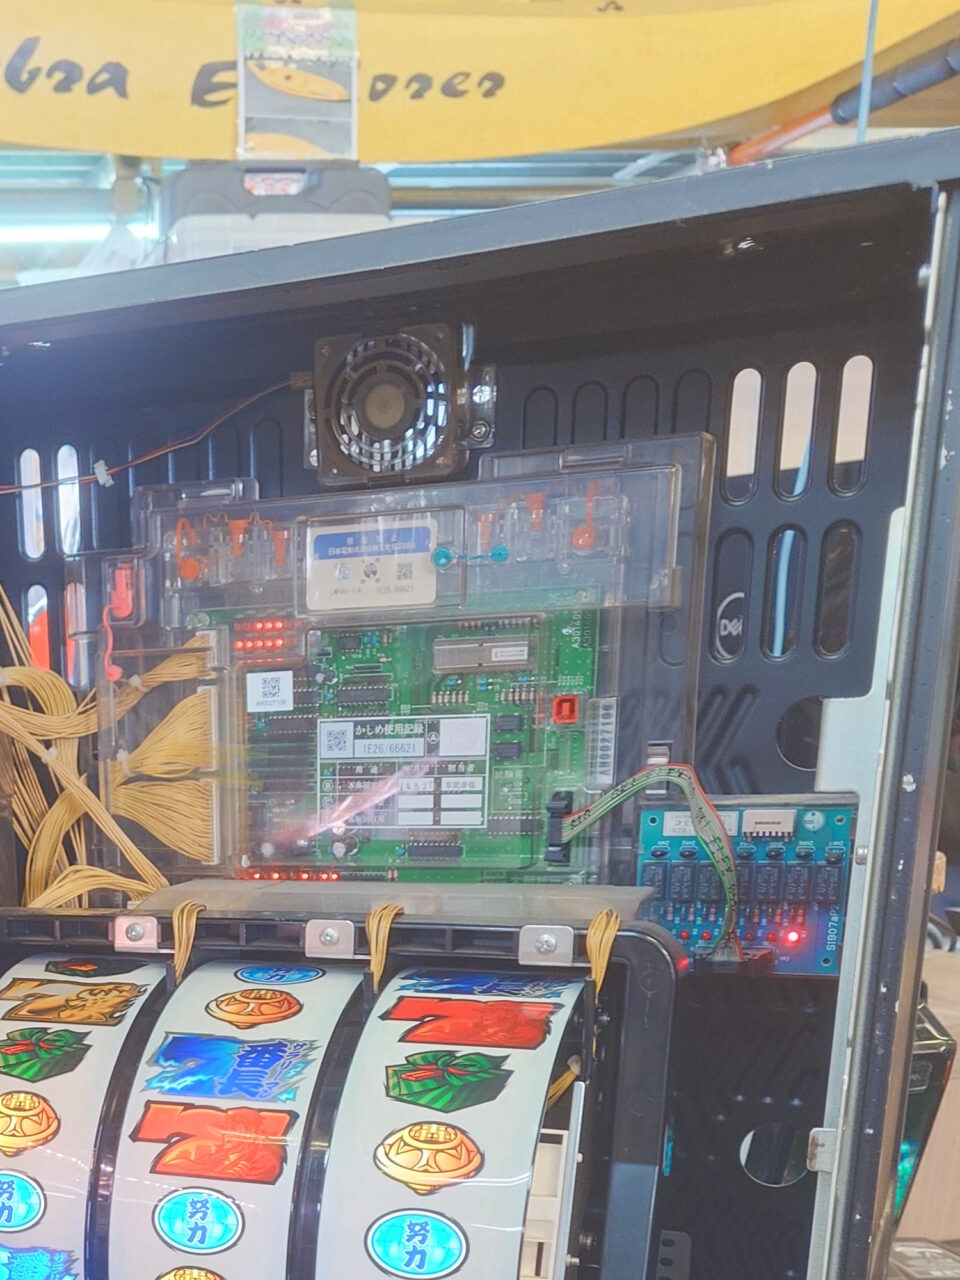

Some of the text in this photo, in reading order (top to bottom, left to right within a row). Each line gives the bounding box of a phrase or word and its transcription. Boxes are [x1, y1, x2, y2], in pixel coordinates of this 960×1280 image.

[355, 723, 424, 736] かしめ使用記録
[187, 1197, 210, 1245] 努力
[403, 1219, 431, 1270] 努力
